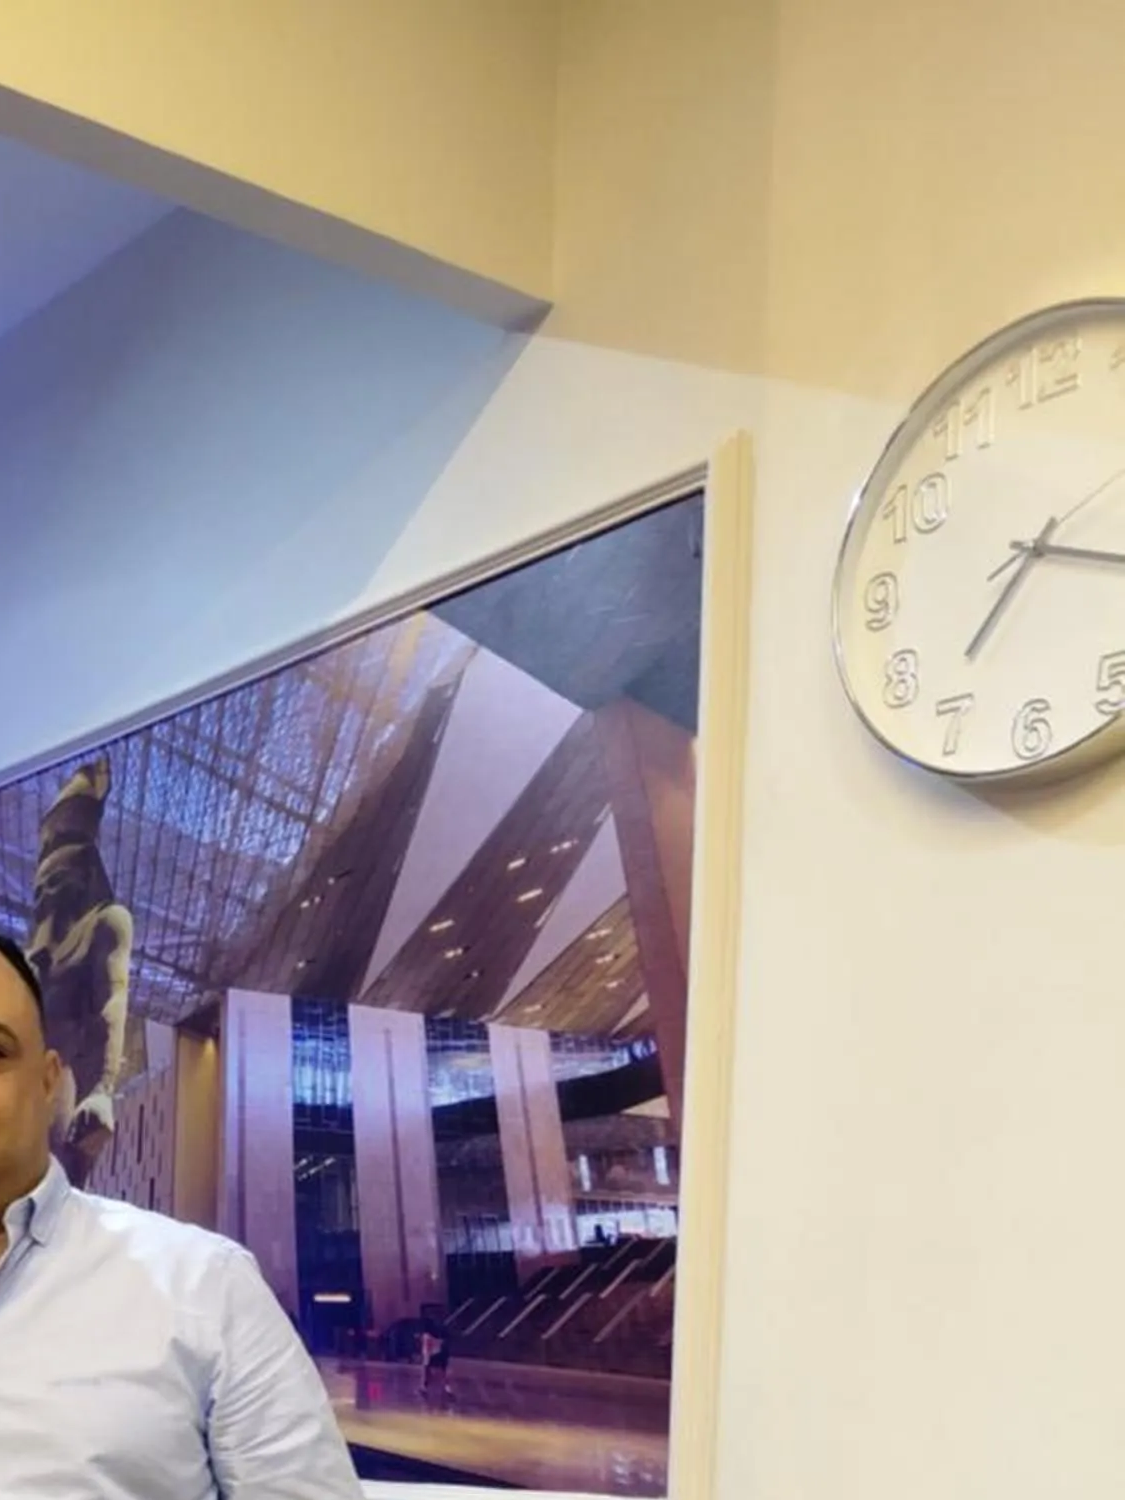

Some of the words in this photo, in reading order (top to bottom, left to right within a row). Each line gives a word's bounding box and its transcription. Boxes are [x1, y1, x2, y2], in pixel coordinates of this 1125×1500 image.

[1004, 337, 1082, 410] 12
[933, 386, 995, 461] 11
[883, 471, 952, 544] 10
[864, 571, 900, 632] 9
[883, 648, 920, 709] 8
[1095, 650, 1125, 715] 5
[936, 692, 975, 756] 7
[1011, 698, 1052, 760] 6
